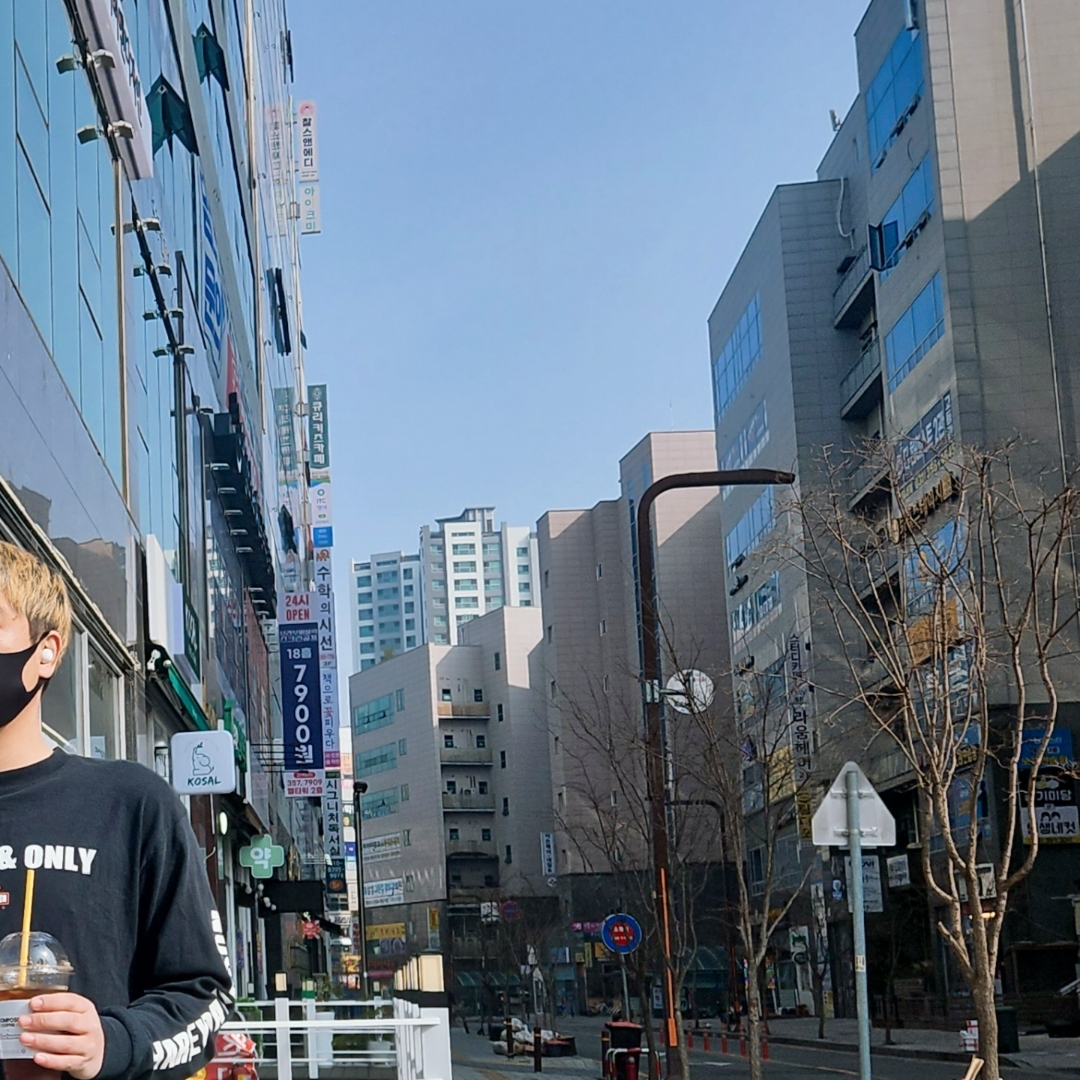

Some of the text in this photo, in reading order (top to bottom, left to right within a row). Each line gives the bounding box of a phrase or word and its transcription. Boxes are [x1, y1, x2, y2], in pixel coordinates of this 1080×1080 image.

[286, 608, 310, 622] OPEN
[187, 776, 221, 787] KOSAL
[24, 844, 97, 875] ONLY
[250, 847, 272, 870] 약
